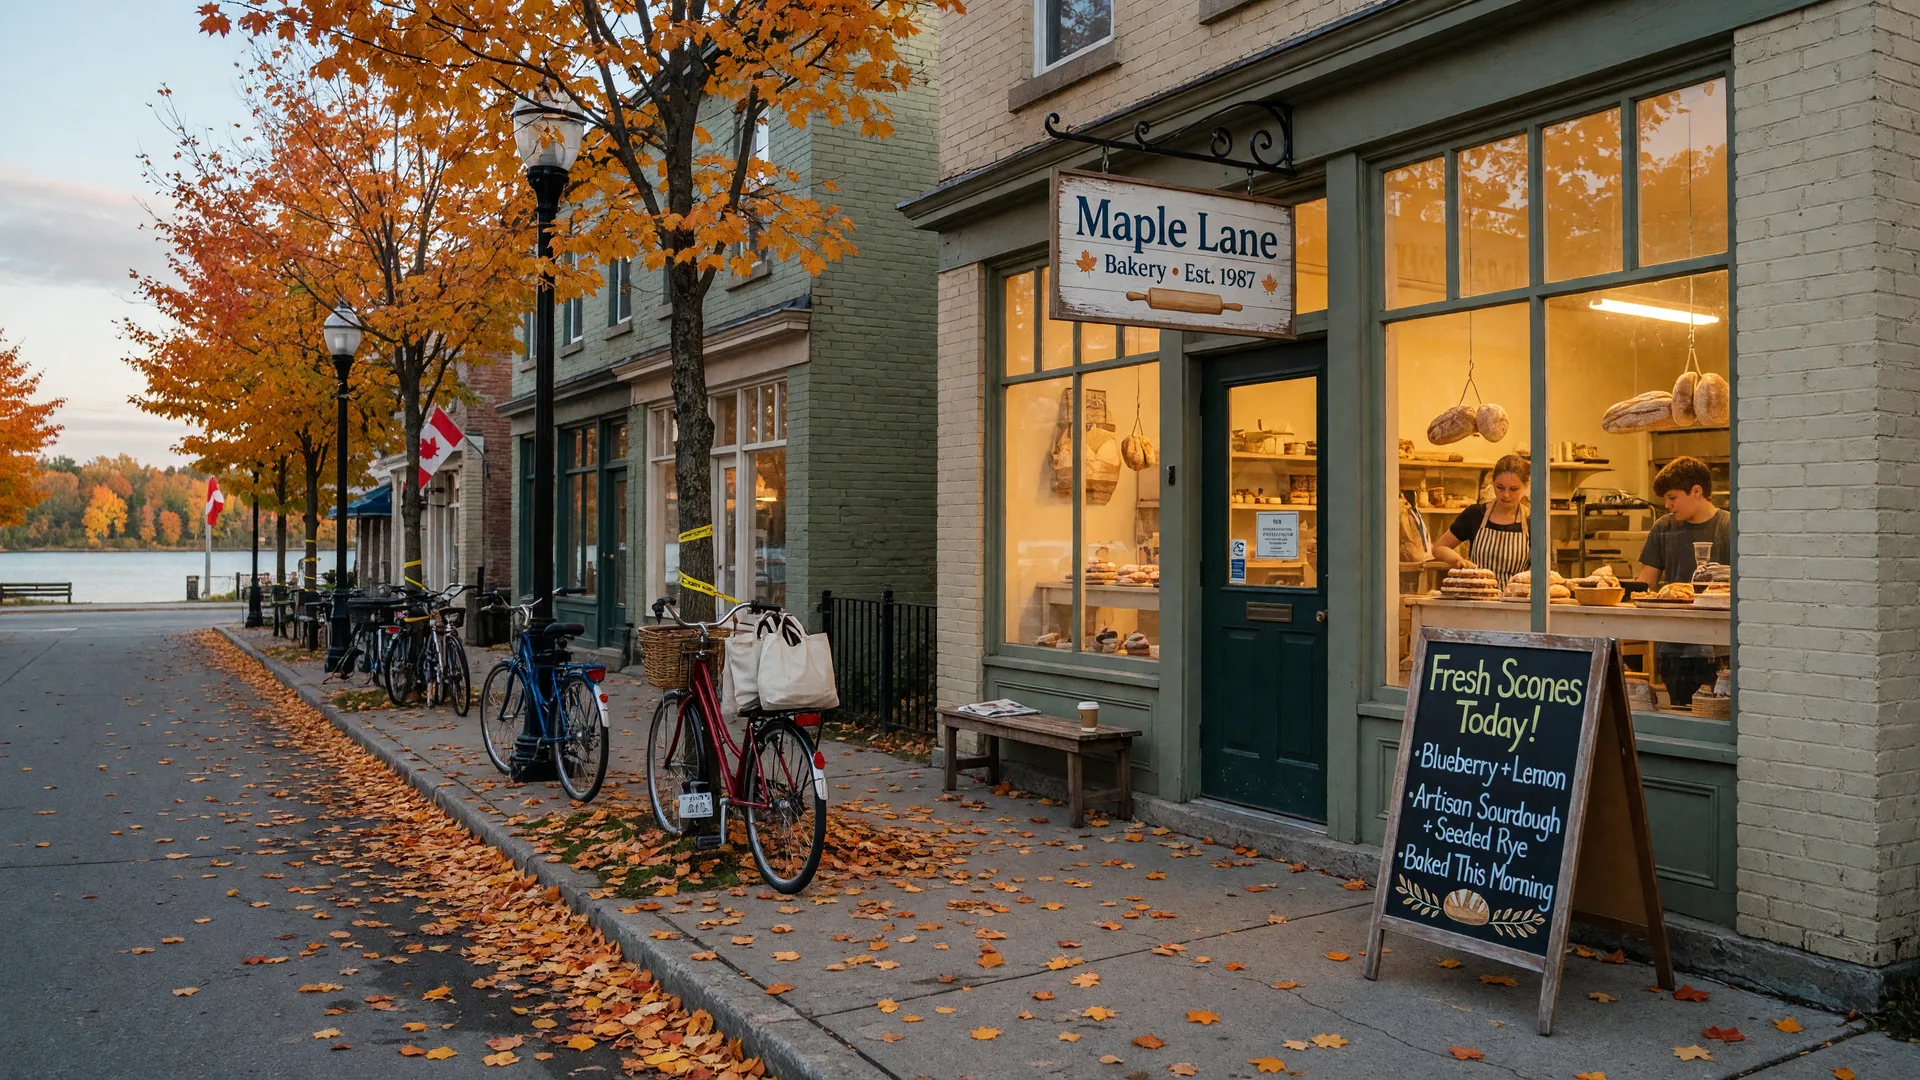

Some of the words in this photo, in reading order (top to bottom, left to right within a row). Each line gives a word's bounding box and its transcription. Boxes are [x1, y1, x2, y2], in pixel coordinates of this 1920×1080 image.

[1076, 195, 1187, 254] Maple
[1198, 212, 1278, 260] Lane
[1104, 253, 1167, 284] Bakery
[1184, 263, 1215, 285] Est.
[1219, 268, 1256, 289] 1987
[1429, 654, 1491, 696] Fresh
[1497, 657, 1583, 706] Scones
[1456, 700, 1541, 753] Today!
[1420, 742, 1498, 787] Blueberry
[1512, 755, 1566, 791] Lemon
[1412, 783, 1472, 818] Artisan
[1476, 792, 1561, 842] Sourdough
[1435, 816, 1492, 851] Seeded
[1496, 827, 1528, 865] Rye
[1404, 843, 1451, 878] Baked
[1454, 853, 1486, 886] This
[1489, 861, 1554, 912] Morning
